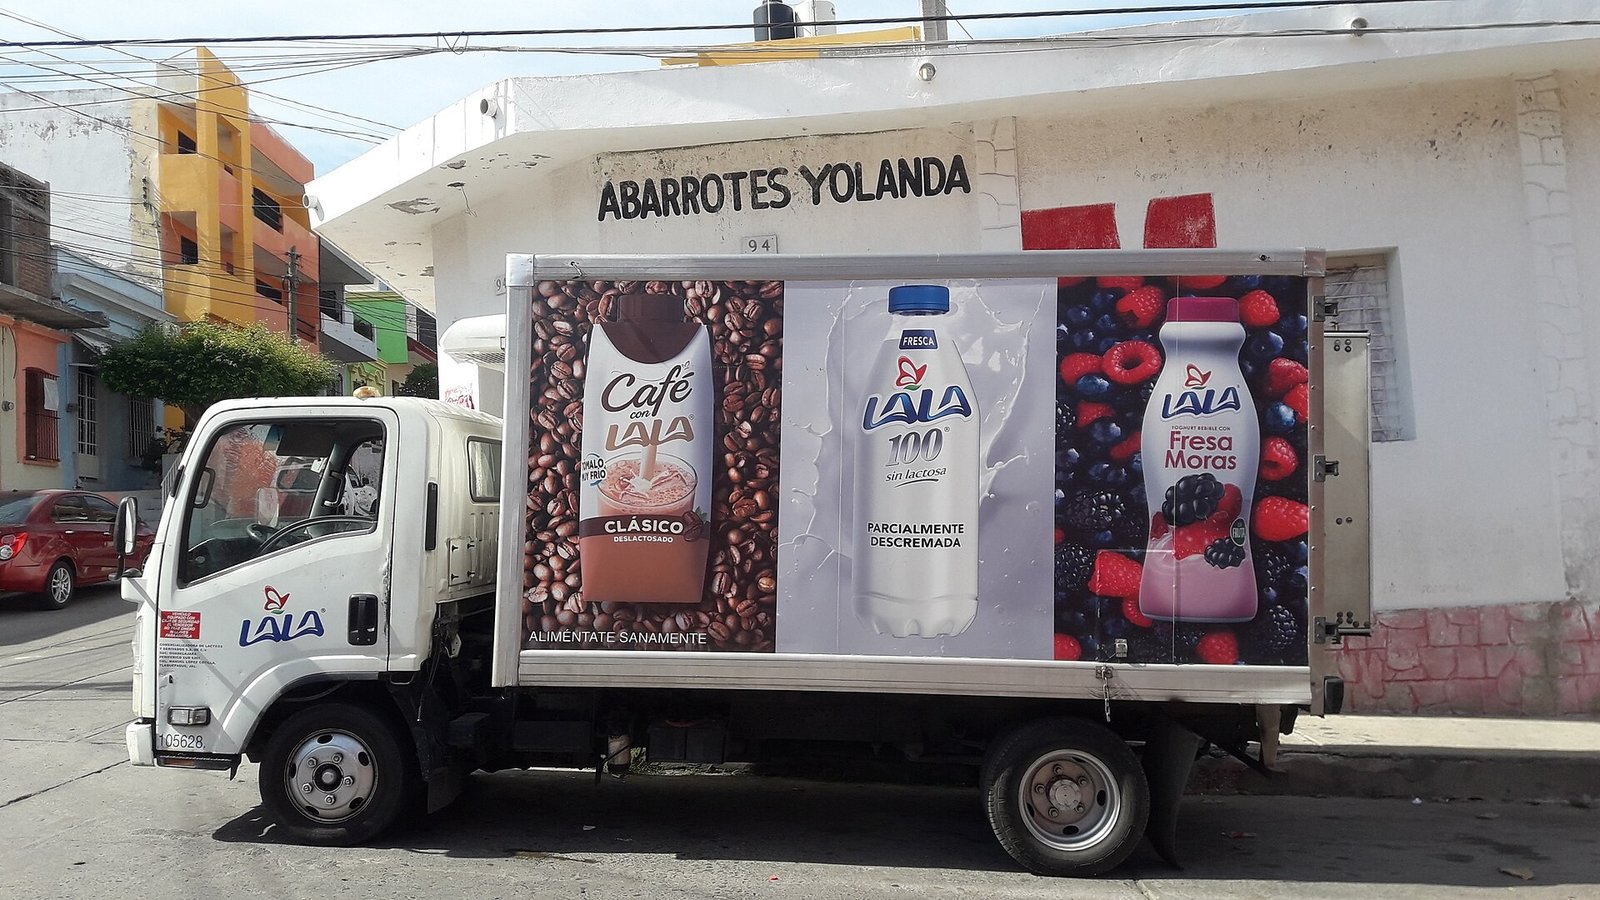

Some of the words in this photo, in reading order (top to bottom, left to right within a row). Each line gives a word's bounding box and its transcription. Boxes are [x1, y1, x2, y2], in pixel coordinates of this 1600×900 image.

[597, 166, 791, 221] ABARROTES
[799, 154, 971, 206] YOLANDA
[748, 239, 771, 252] 94
[902, 336, 935, 346] FRESCA
[601, 364, 694, 417] Café
[863, 385, 972, 431] LALA
[1161, 386, 1241, 419] LALA
[629, 408, 650, 419] con
[605, 416, 694, 451] LALA
[1169, 430, 1233, 451] Fresa
[885, 428, 943, 467] 100
[1164, 449, 1237, 471] Moras
[885, 471, 903, 482] sin
[905, 466, 947, 479] lactosa
[604, 516, 684, 534] CLÁSICO
[867, 522, 964, 534] PARCIALMENTE
[613, 535, 674, 543] DESLACTOSADO
[870, 536, 961, 548] DESCREMADA
[239, 610, 325, 647] LALA
[528, 628, 616, 643] ALIMÉNTATE
[619, 632, 707, 645] SANAMENTE
